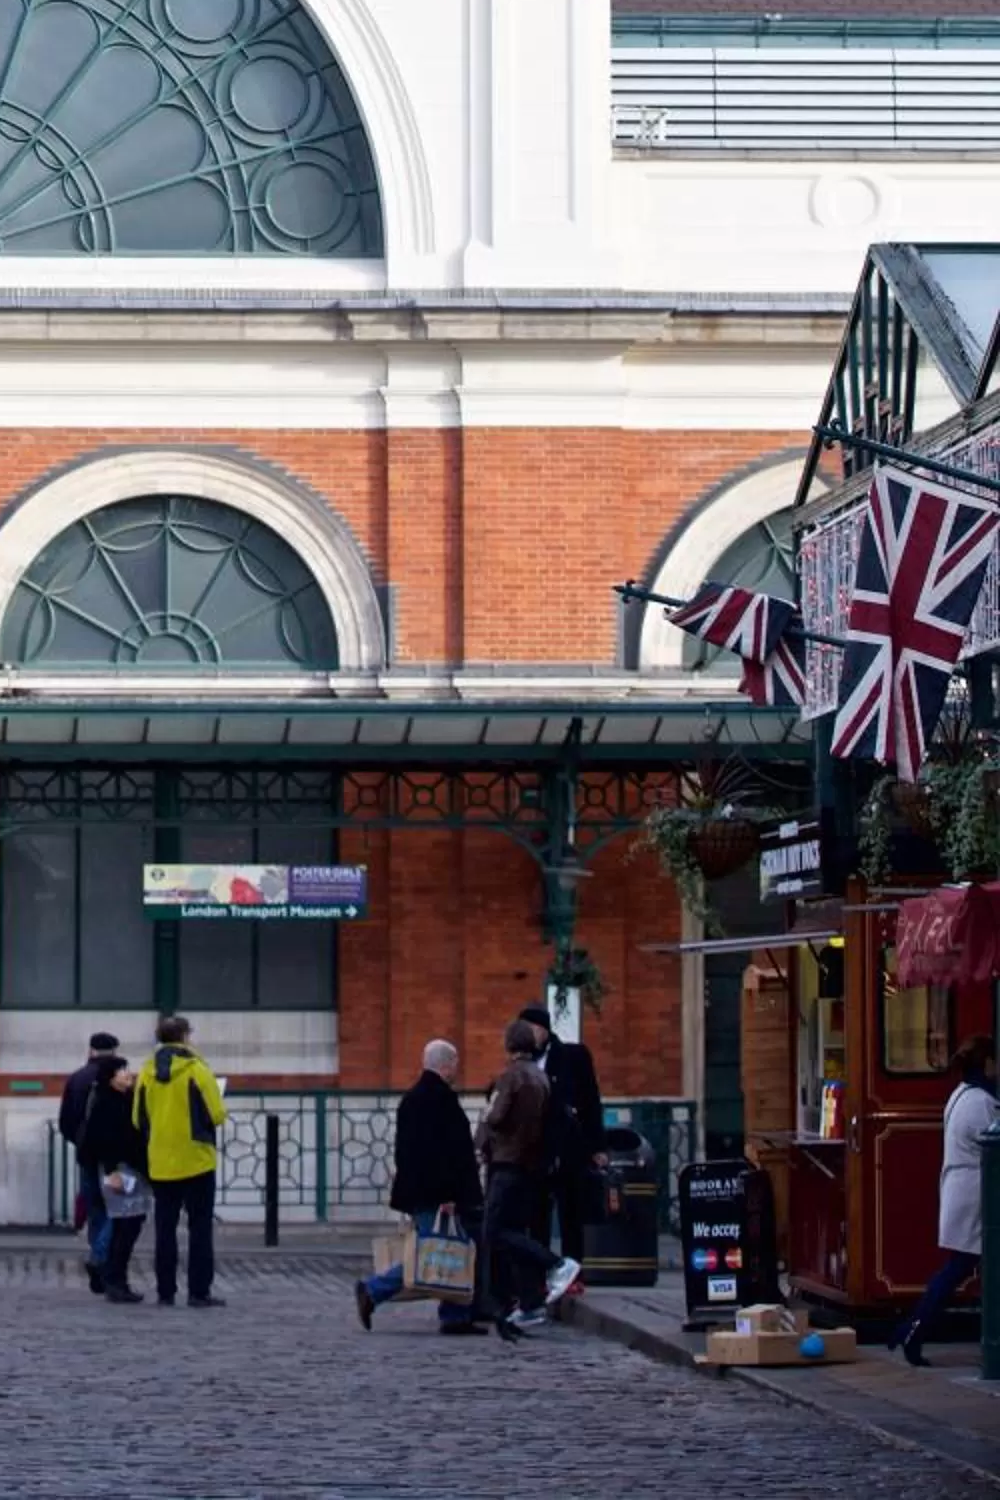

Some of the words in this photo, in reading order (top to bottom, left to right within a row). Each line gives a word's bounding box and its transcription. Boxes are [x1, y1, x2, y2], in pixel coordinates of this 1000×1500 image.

[181, 905, 227, 917] London
[231, 905, 288, 919] Transport
[290, 905, 341, 917] Museum
[692, 1221, 710, 1238] We
